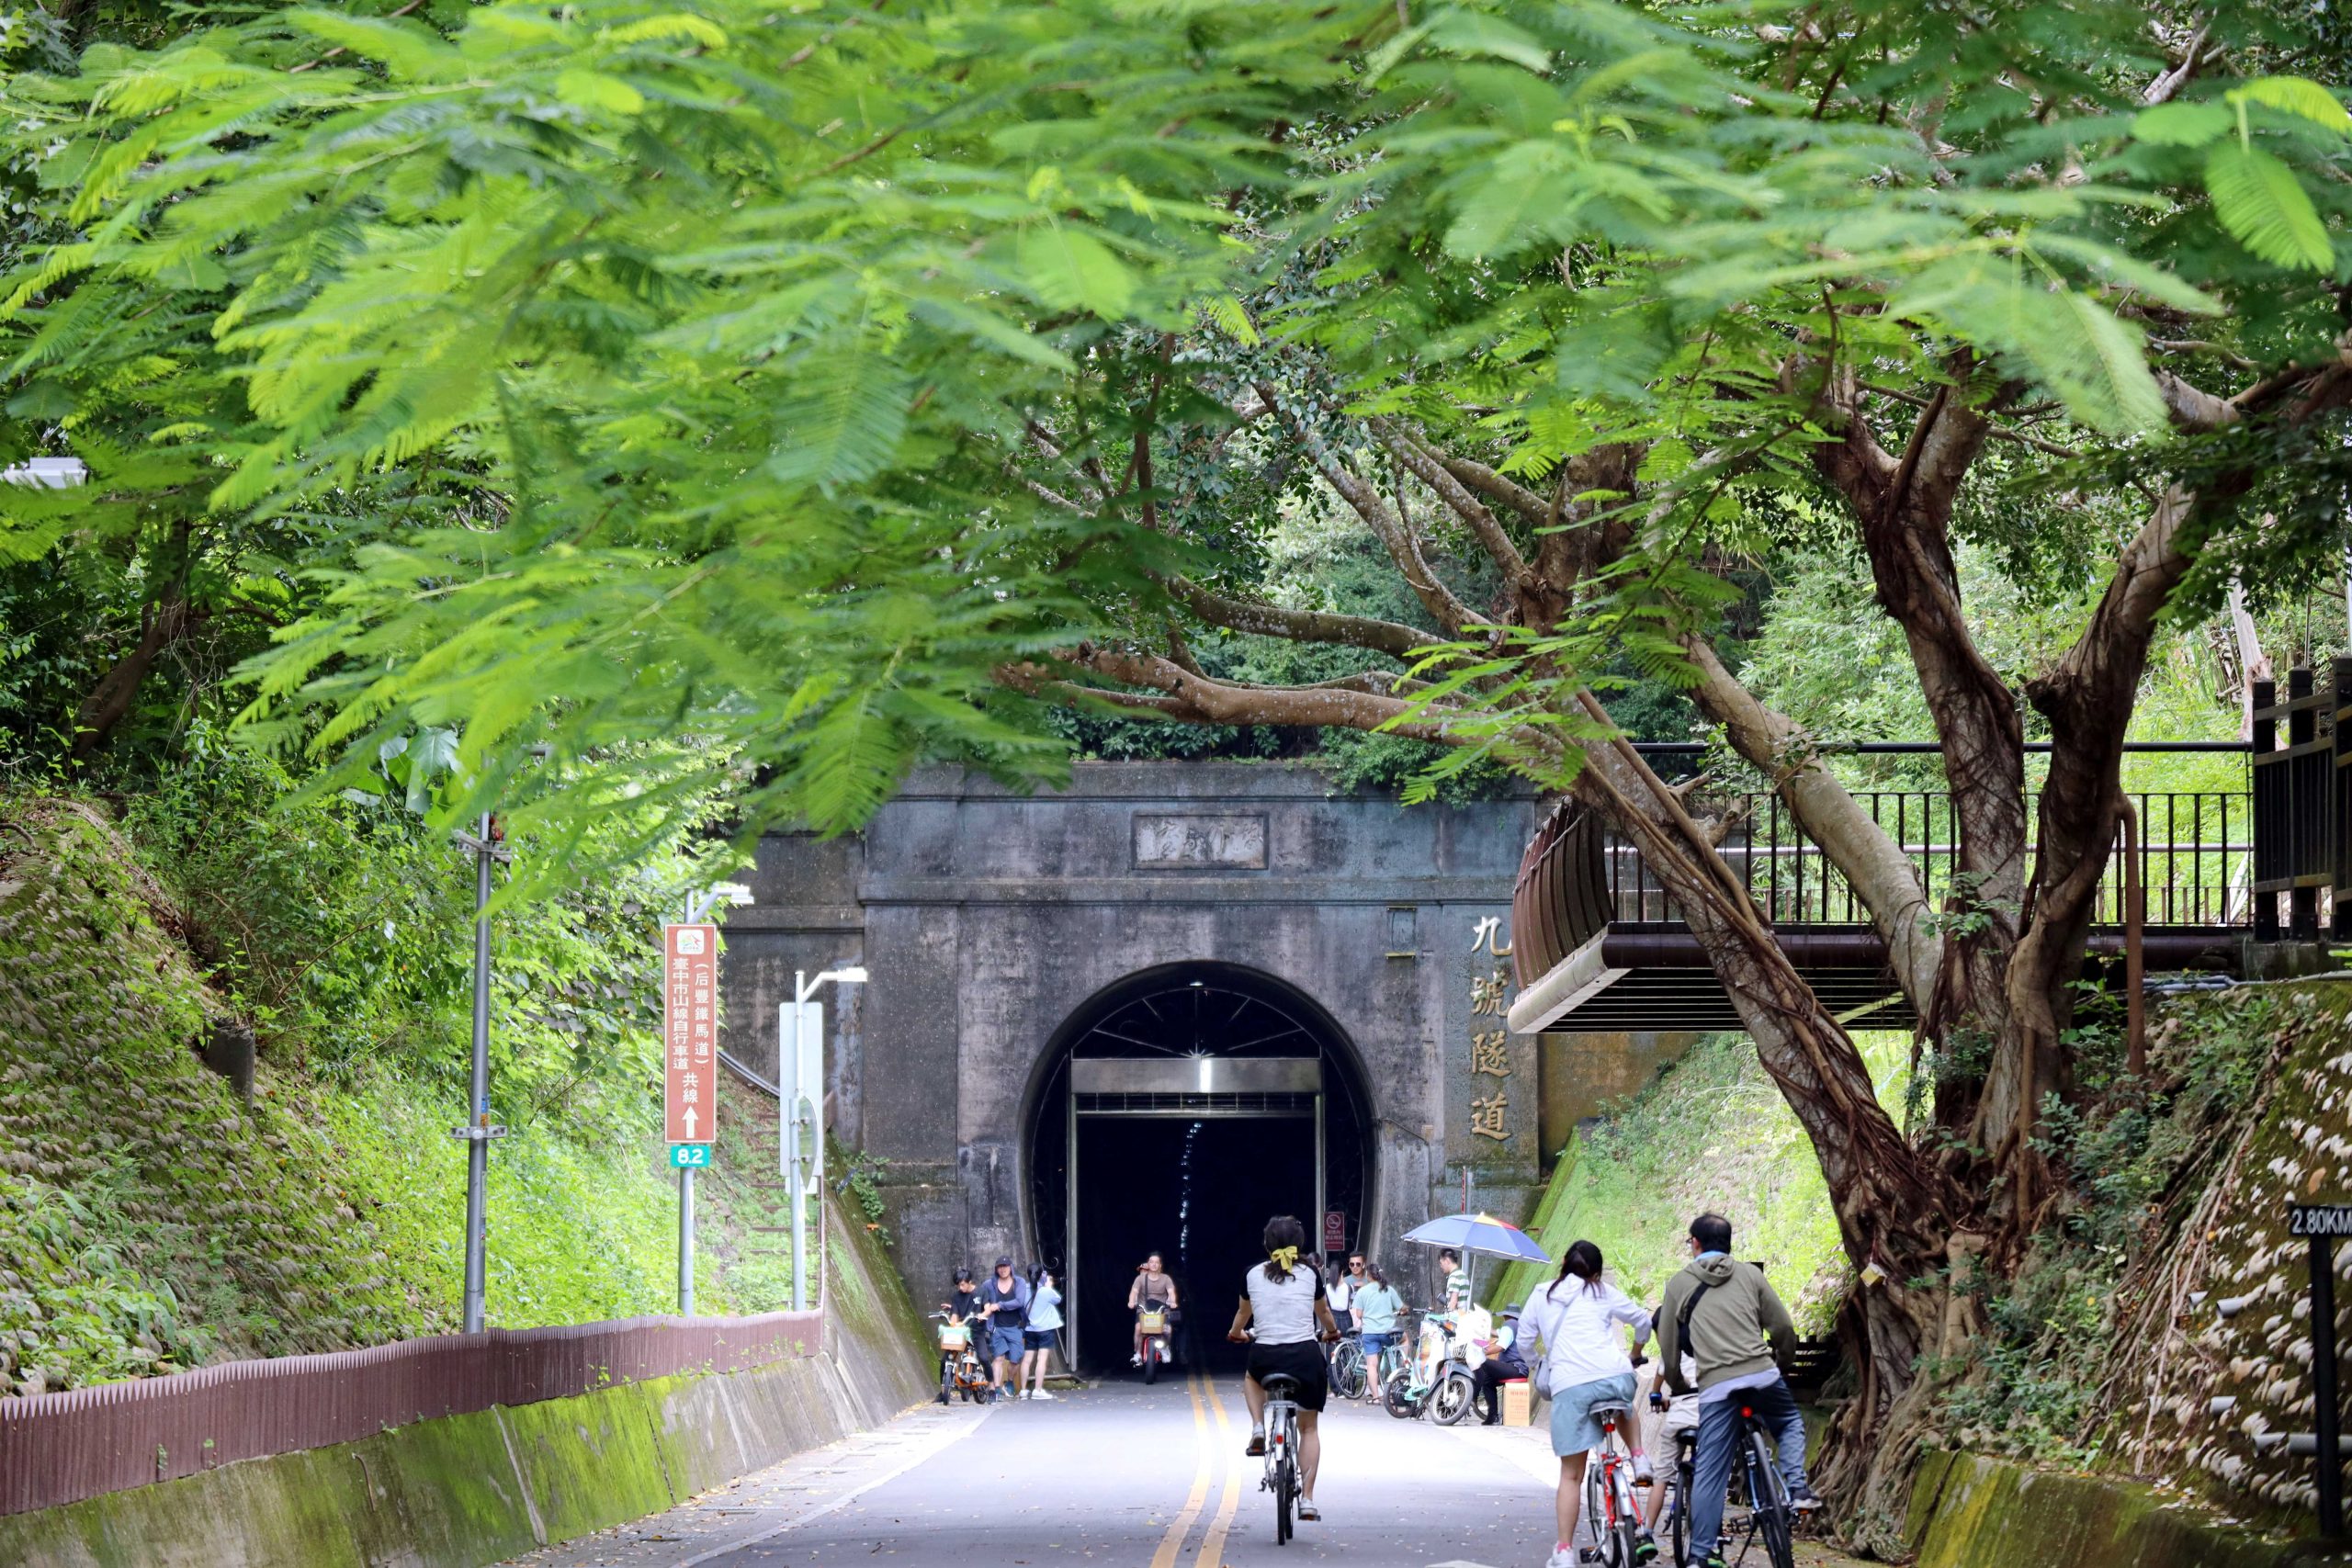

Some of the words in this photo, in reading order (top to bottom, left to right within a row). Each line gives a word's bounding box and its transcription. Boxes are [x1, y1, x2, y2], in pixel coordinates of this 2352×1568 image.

[673, 957, 689, 1070] 臺中市山線自行車道
[1470, 916, 1513, 1141] 九號隧道
[682, 1072, 698, 1103] 共線
[677, 1148, 704, 1165] 8.2
[2291, 1208, 2352, 1235] 2.80KM
